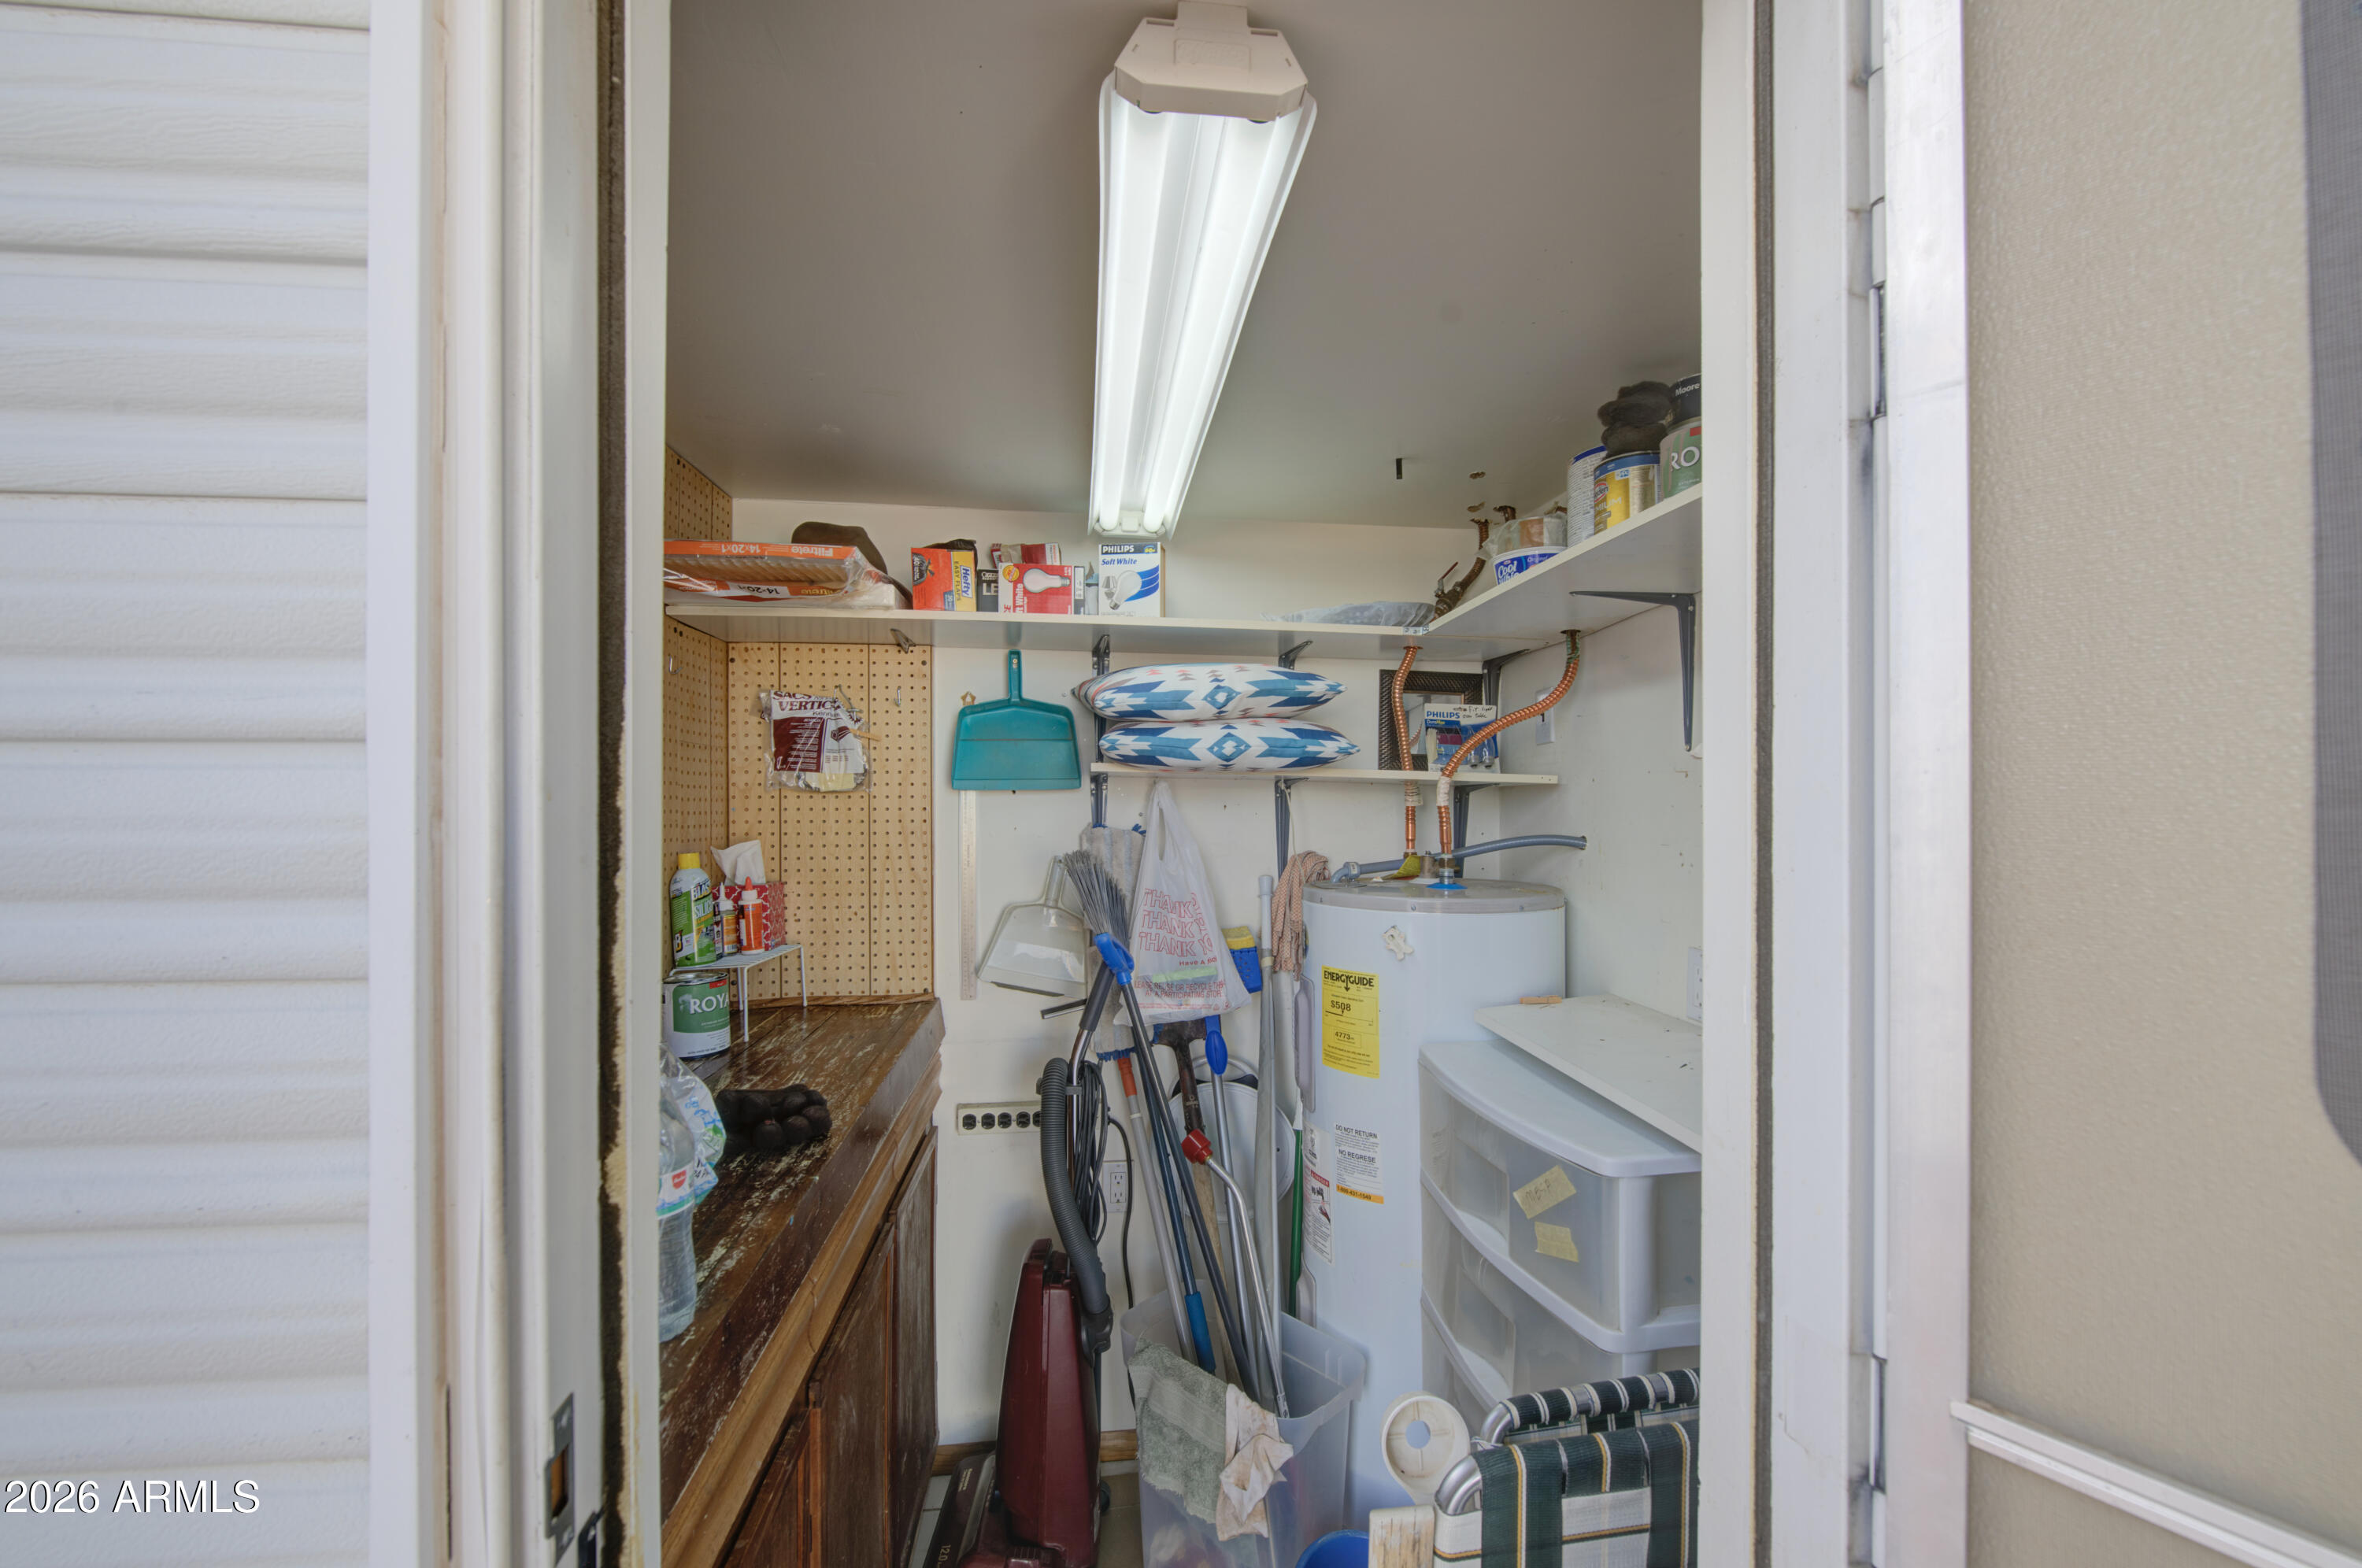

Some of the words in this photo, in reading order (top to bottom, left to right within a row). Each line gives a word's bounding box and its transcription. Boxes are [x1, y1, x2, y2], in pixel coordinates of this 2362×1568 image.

[1675, 382, 1701, 397] Moore
[790, 545, 834, 557] Filtrete
[1102, 545, 1135, 553] PHILIPS
[1101, 557, 1116, 566] Soft
[1498, 560, 1518, 579] Cool
[961, 567, 972, 597] Hefty
[1015, 583, 1024, 605] White
[772, 690, 813, 701] SACS
[1426, 710, 1461, 719] PHILIPS
[1142, 909, 1195, 939] THANK
[1138, 931, 1197, 958] THANK
[1186, 982, 1212, 991] RECYCLE
[1161, 989, 1205, 999] PARTICIPATING
[1330, 1000, 1352, 1012] $508
[1335, 1031, 1351, 1040] 4773
[1335, 1123, 1343, 1133] DO
[1343, 1126, 1354, 1135] NOT
[1354, 1129, 1378, 1140] RETURN
[1338, 1148, 1347, 1158] NO
[1347, 1152, 1376, 1164] REGRESE
